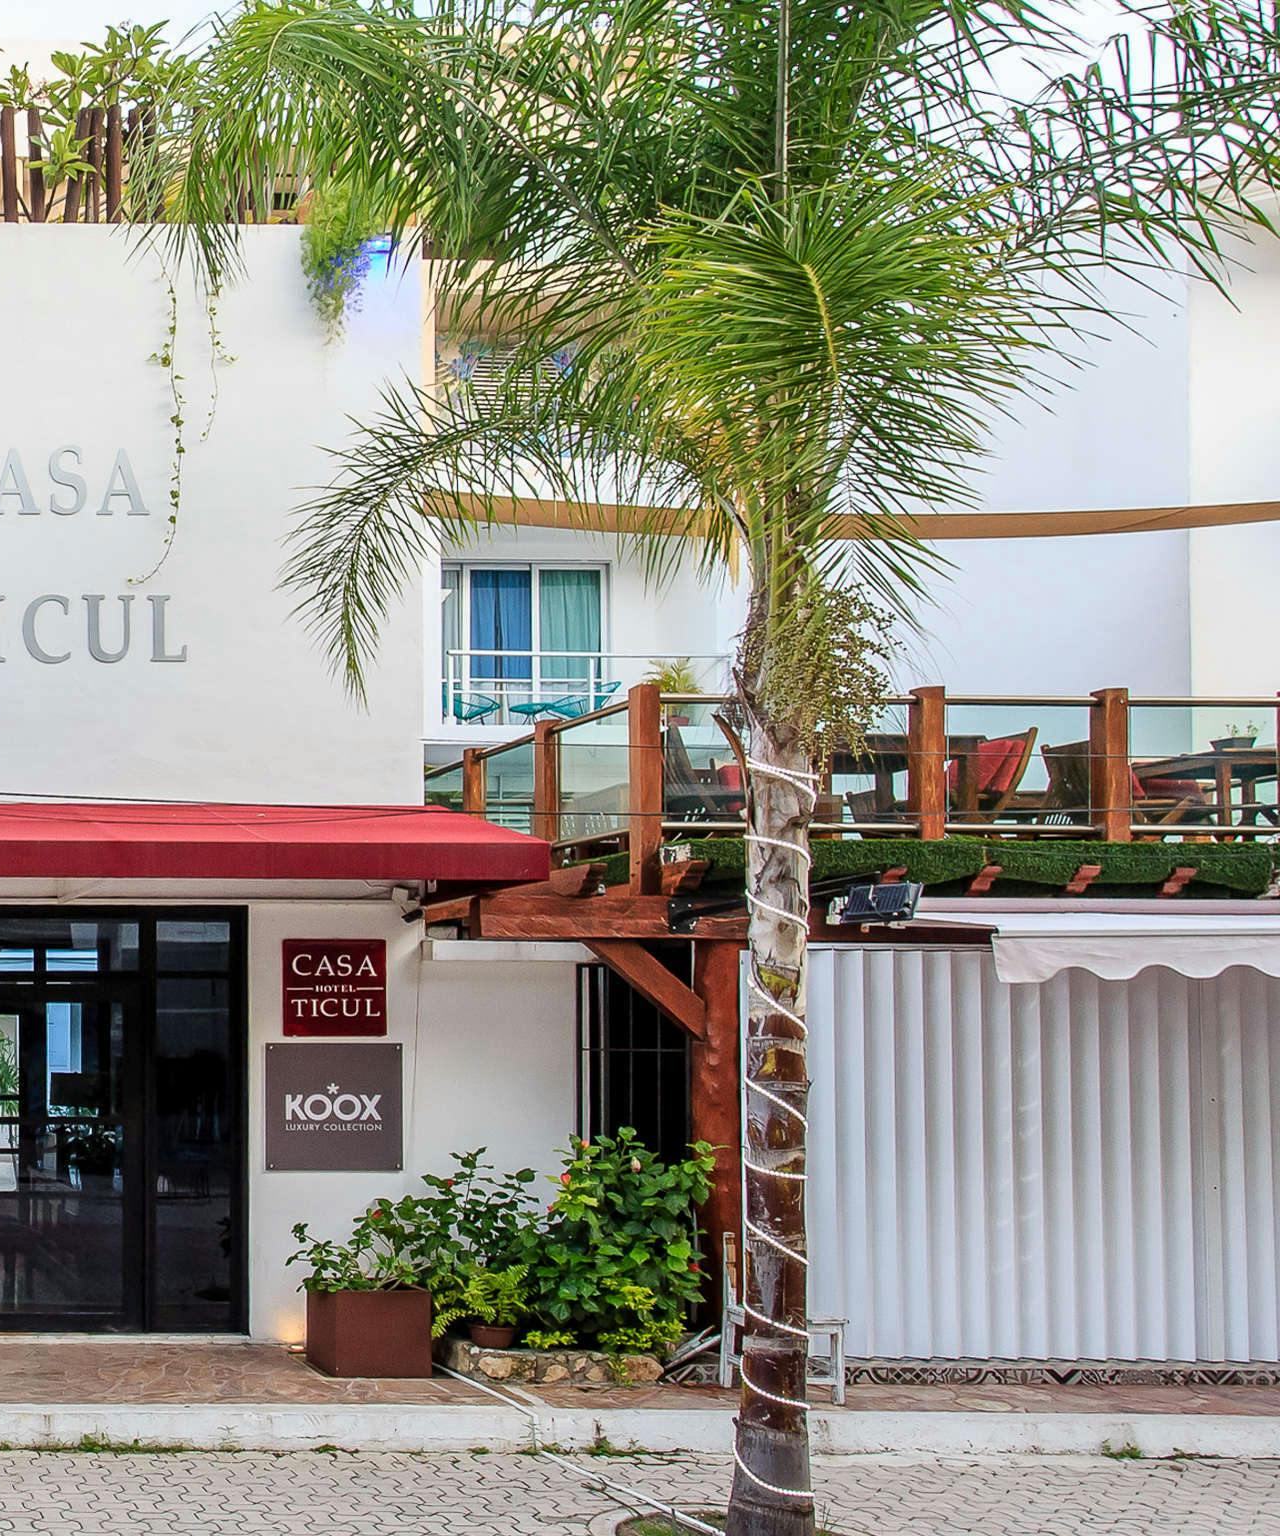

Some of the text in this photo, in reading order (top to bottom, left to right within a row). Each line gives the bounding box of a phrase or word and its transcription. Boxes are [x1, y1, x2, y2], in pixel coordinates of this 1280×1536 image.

[291, 954, 378, 977] CASA
[315, 984, 355, 993] HOTEL
[291, 998, 381, 1018] TICUL
[285, 1094, 382, 1121] KOOX
[285, 1123, 382, 1131] LUXURY COLLECTION
